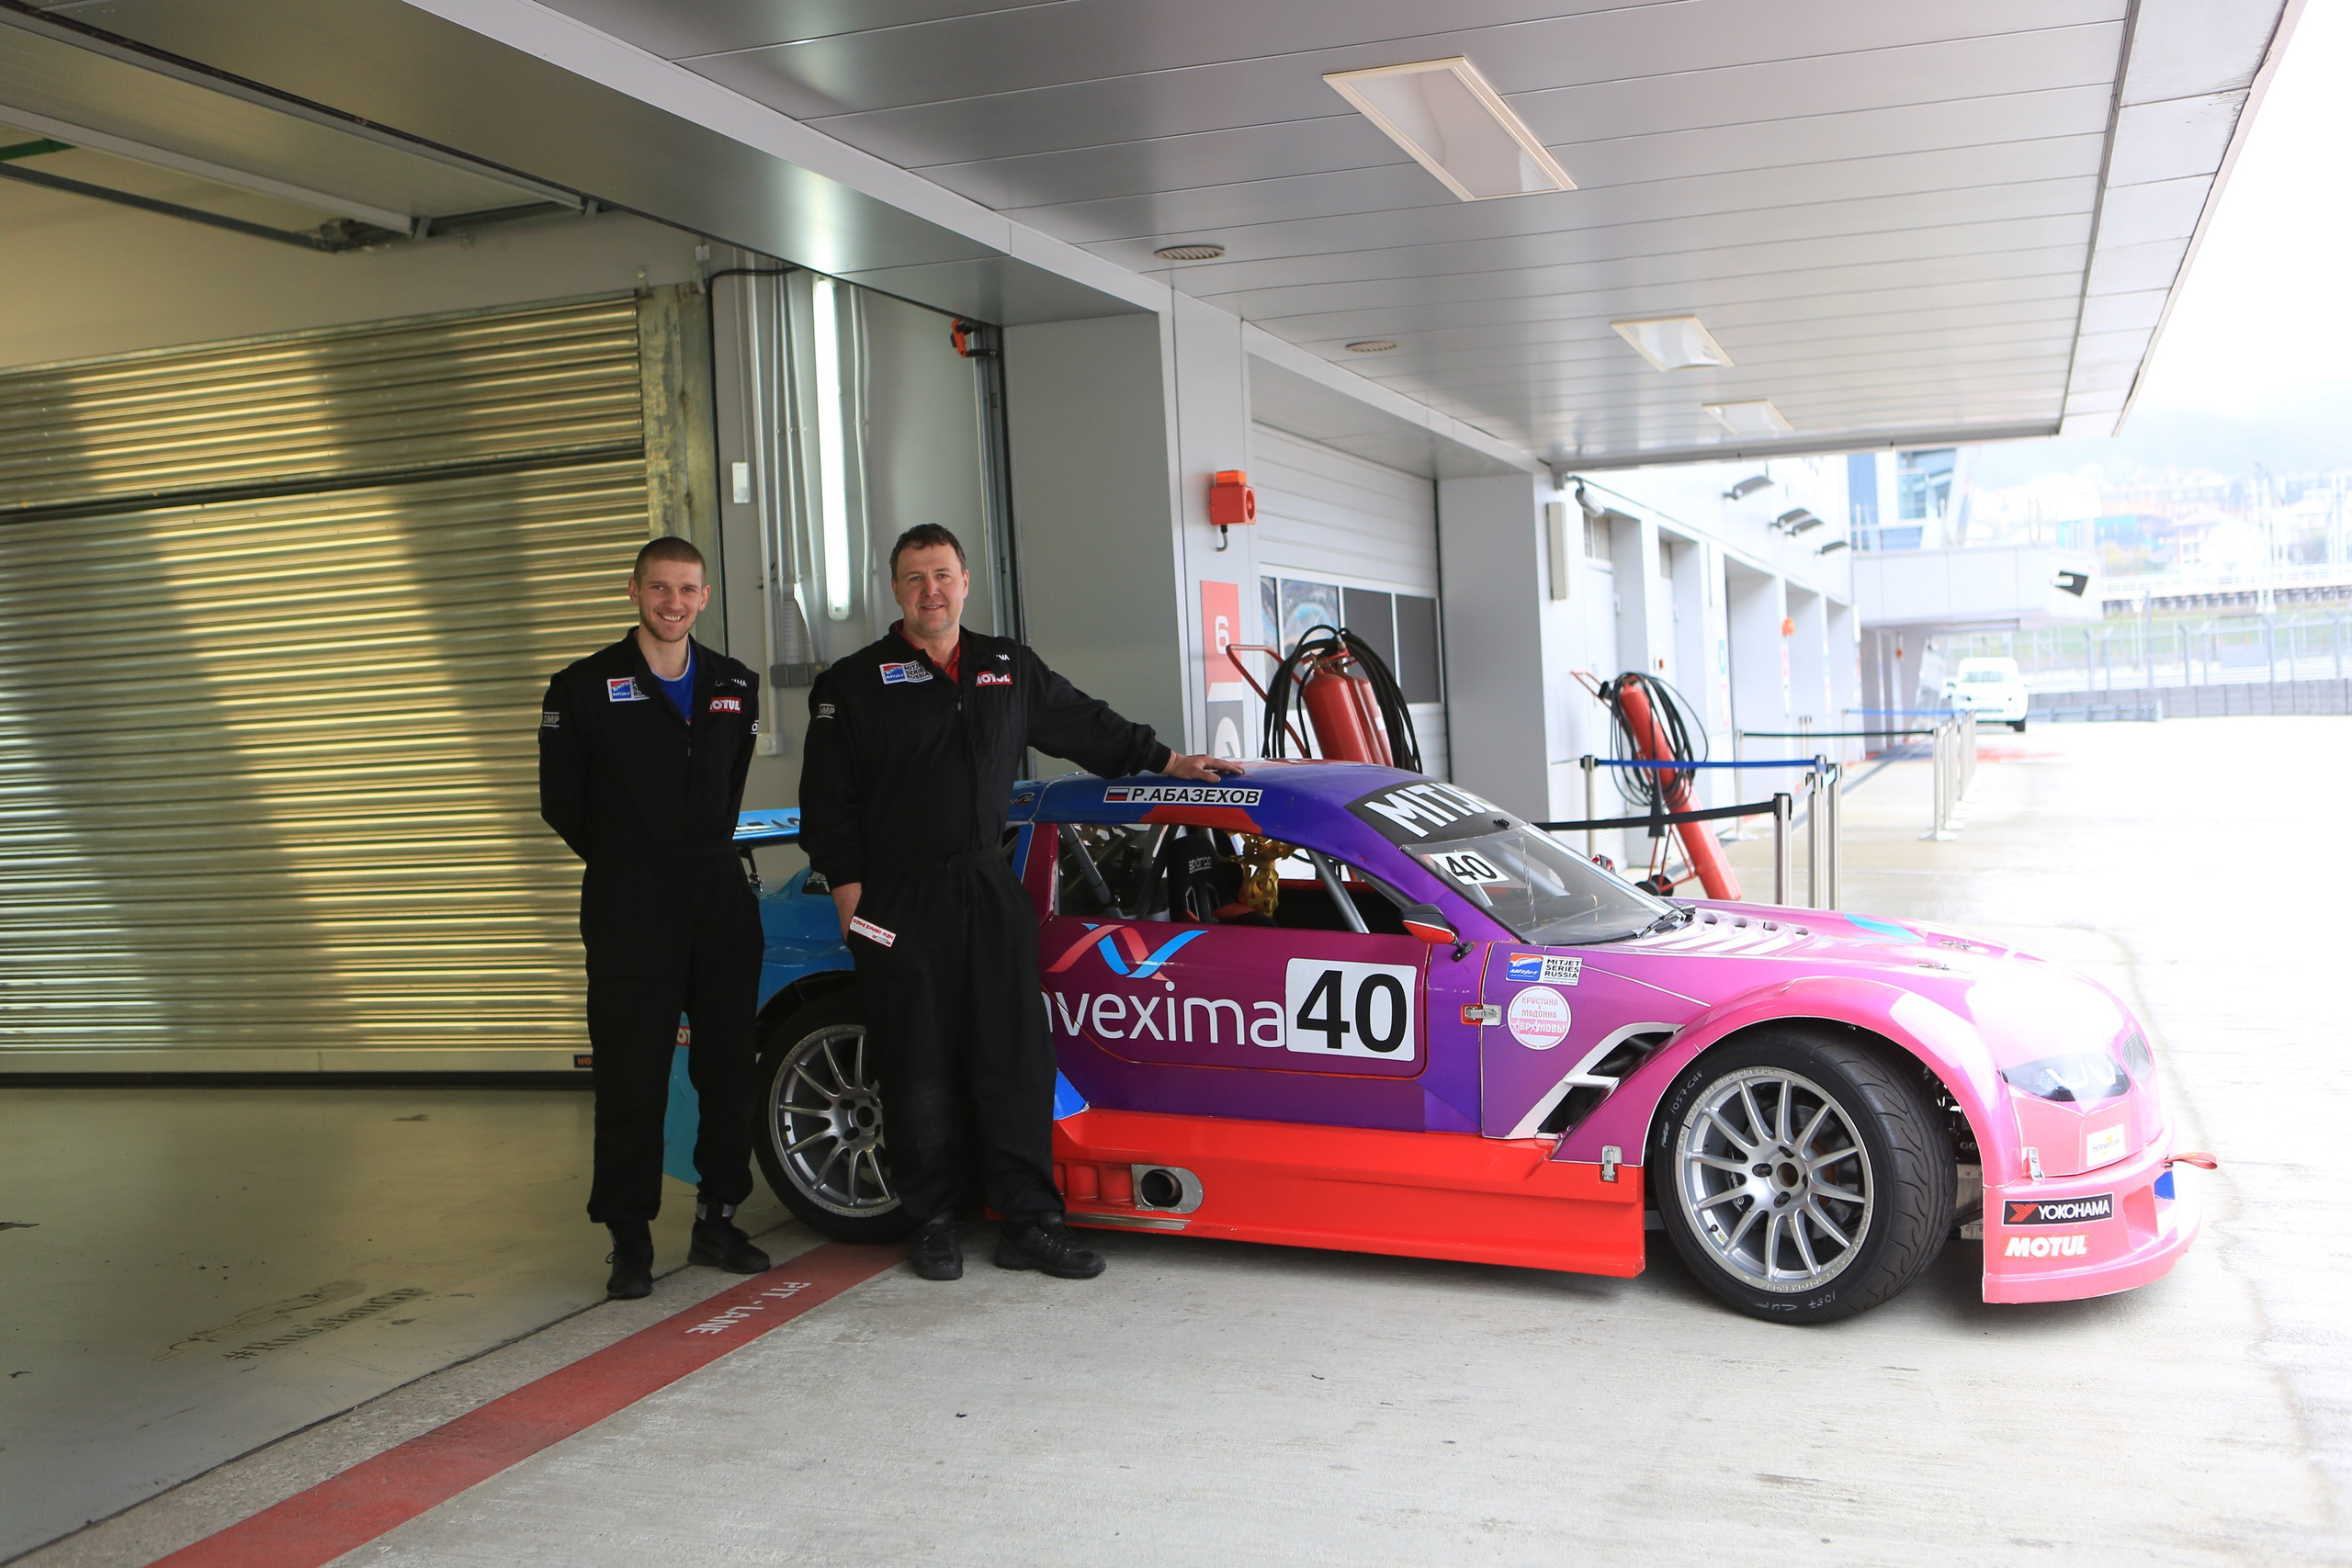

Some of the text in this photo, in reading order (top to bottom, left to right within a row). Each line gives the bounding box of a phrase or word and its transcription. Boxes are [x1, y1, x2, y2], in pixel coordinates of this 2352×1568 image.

[1215, 615, 1230, 655] 6
[1131, 788, 1261, 804] Р.АБАЗЕХОВ
[1445, 855, 1495, 880] 40
[1545, 964, 1579, 973] SERIES
[1296, 970, 1407, 1053] 40
[1521, 997, 1558, 1006] КРИСТИНА
[1521, 1009, 1557, 1019] МАДОННА
[2038, 1199, 2110, 1221] YOKOHAMA
[2005, 1235, 2087, 1258] MOTUL
[761, 1281, 811, 1299] PIT
[684, 1305, 764, 1335] LANE
